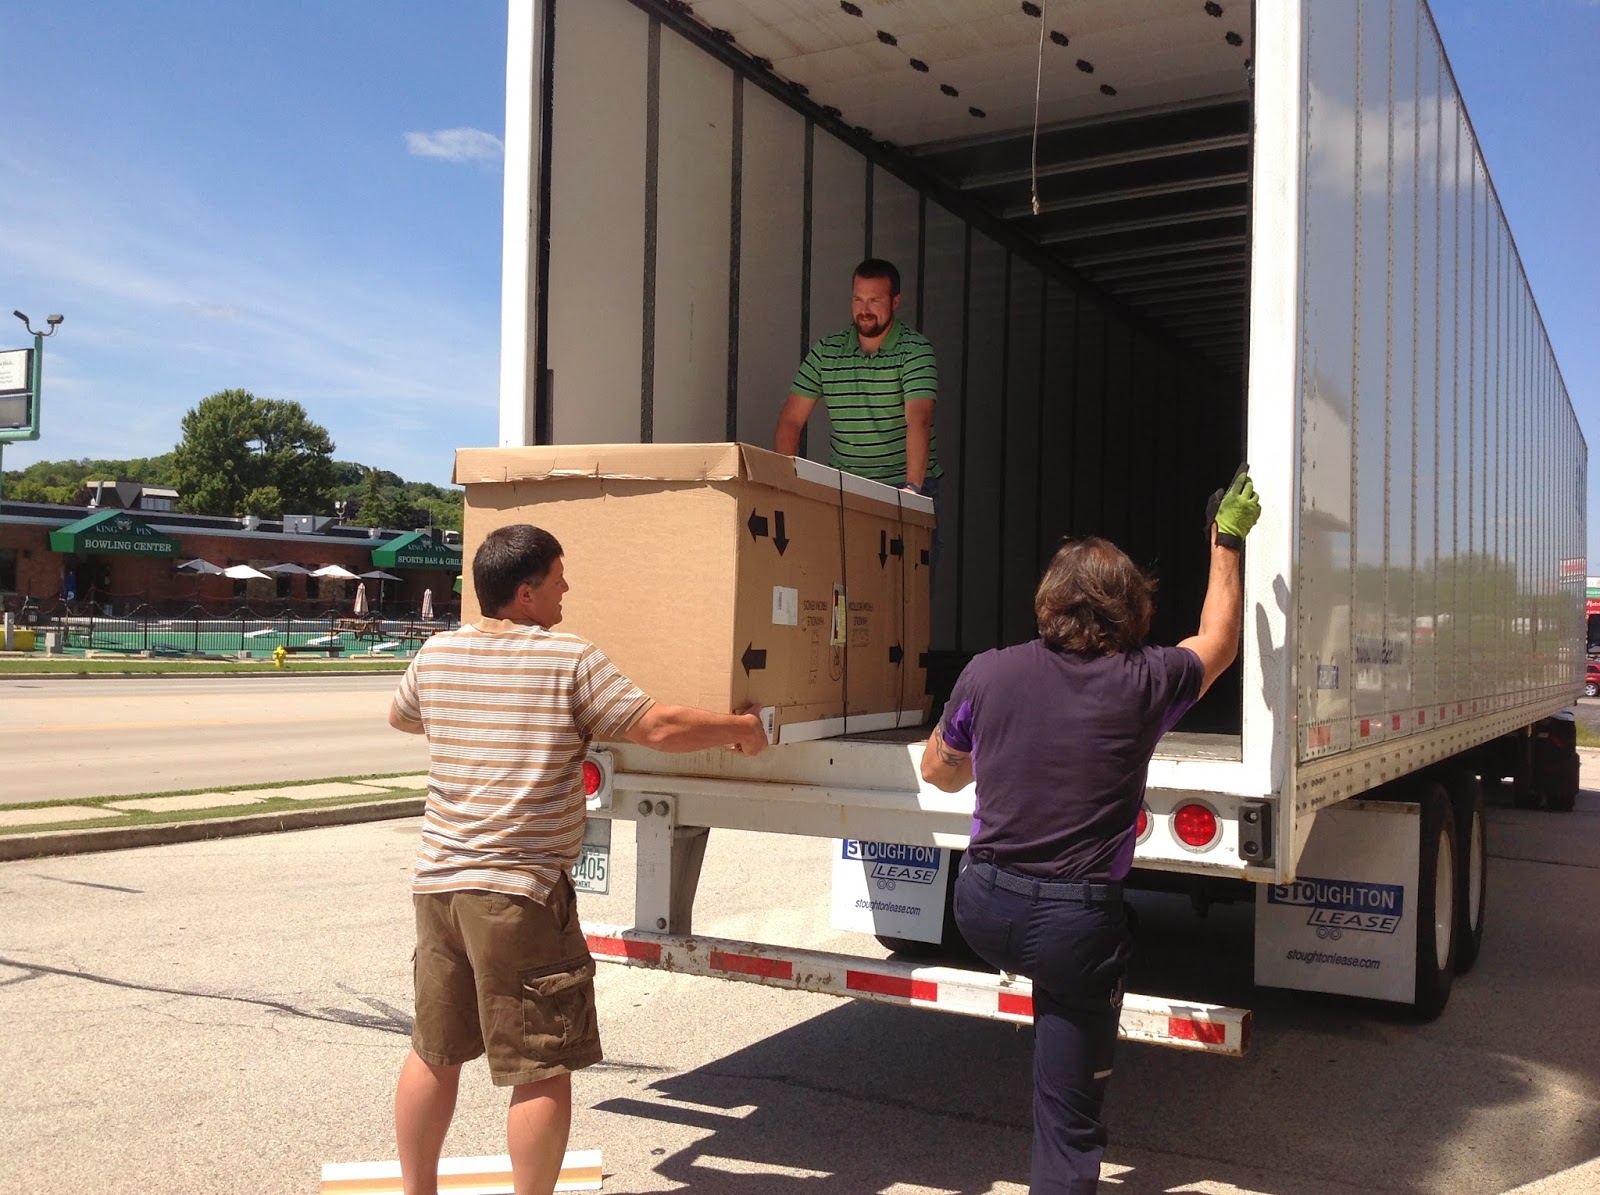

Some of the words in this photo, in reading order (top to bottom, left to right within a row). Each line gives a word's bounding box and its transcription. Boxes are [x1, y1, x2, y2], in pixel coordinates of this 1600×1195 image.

[95, 525, 118, 533] KING
[136, 527, 152, 536] PIN
[84, 539, 132, 550] BOWLING
[133, 541, 172, 552] CENTER
[397, 555, 424, 564] SPORTS
[424, 556, 438, 565] BAR
[847, 840, 935, 863] STOUGHTON
[876, 865, 934, 881] LEASE
[1275, 882, 1395, 909] STOUGHTON
[855, 898, 921, 916] stoughtonlease.com
[1315, 911, 1395, 930] LEASE
[1286, 949, 1381, 969] stoughtonlease.com
